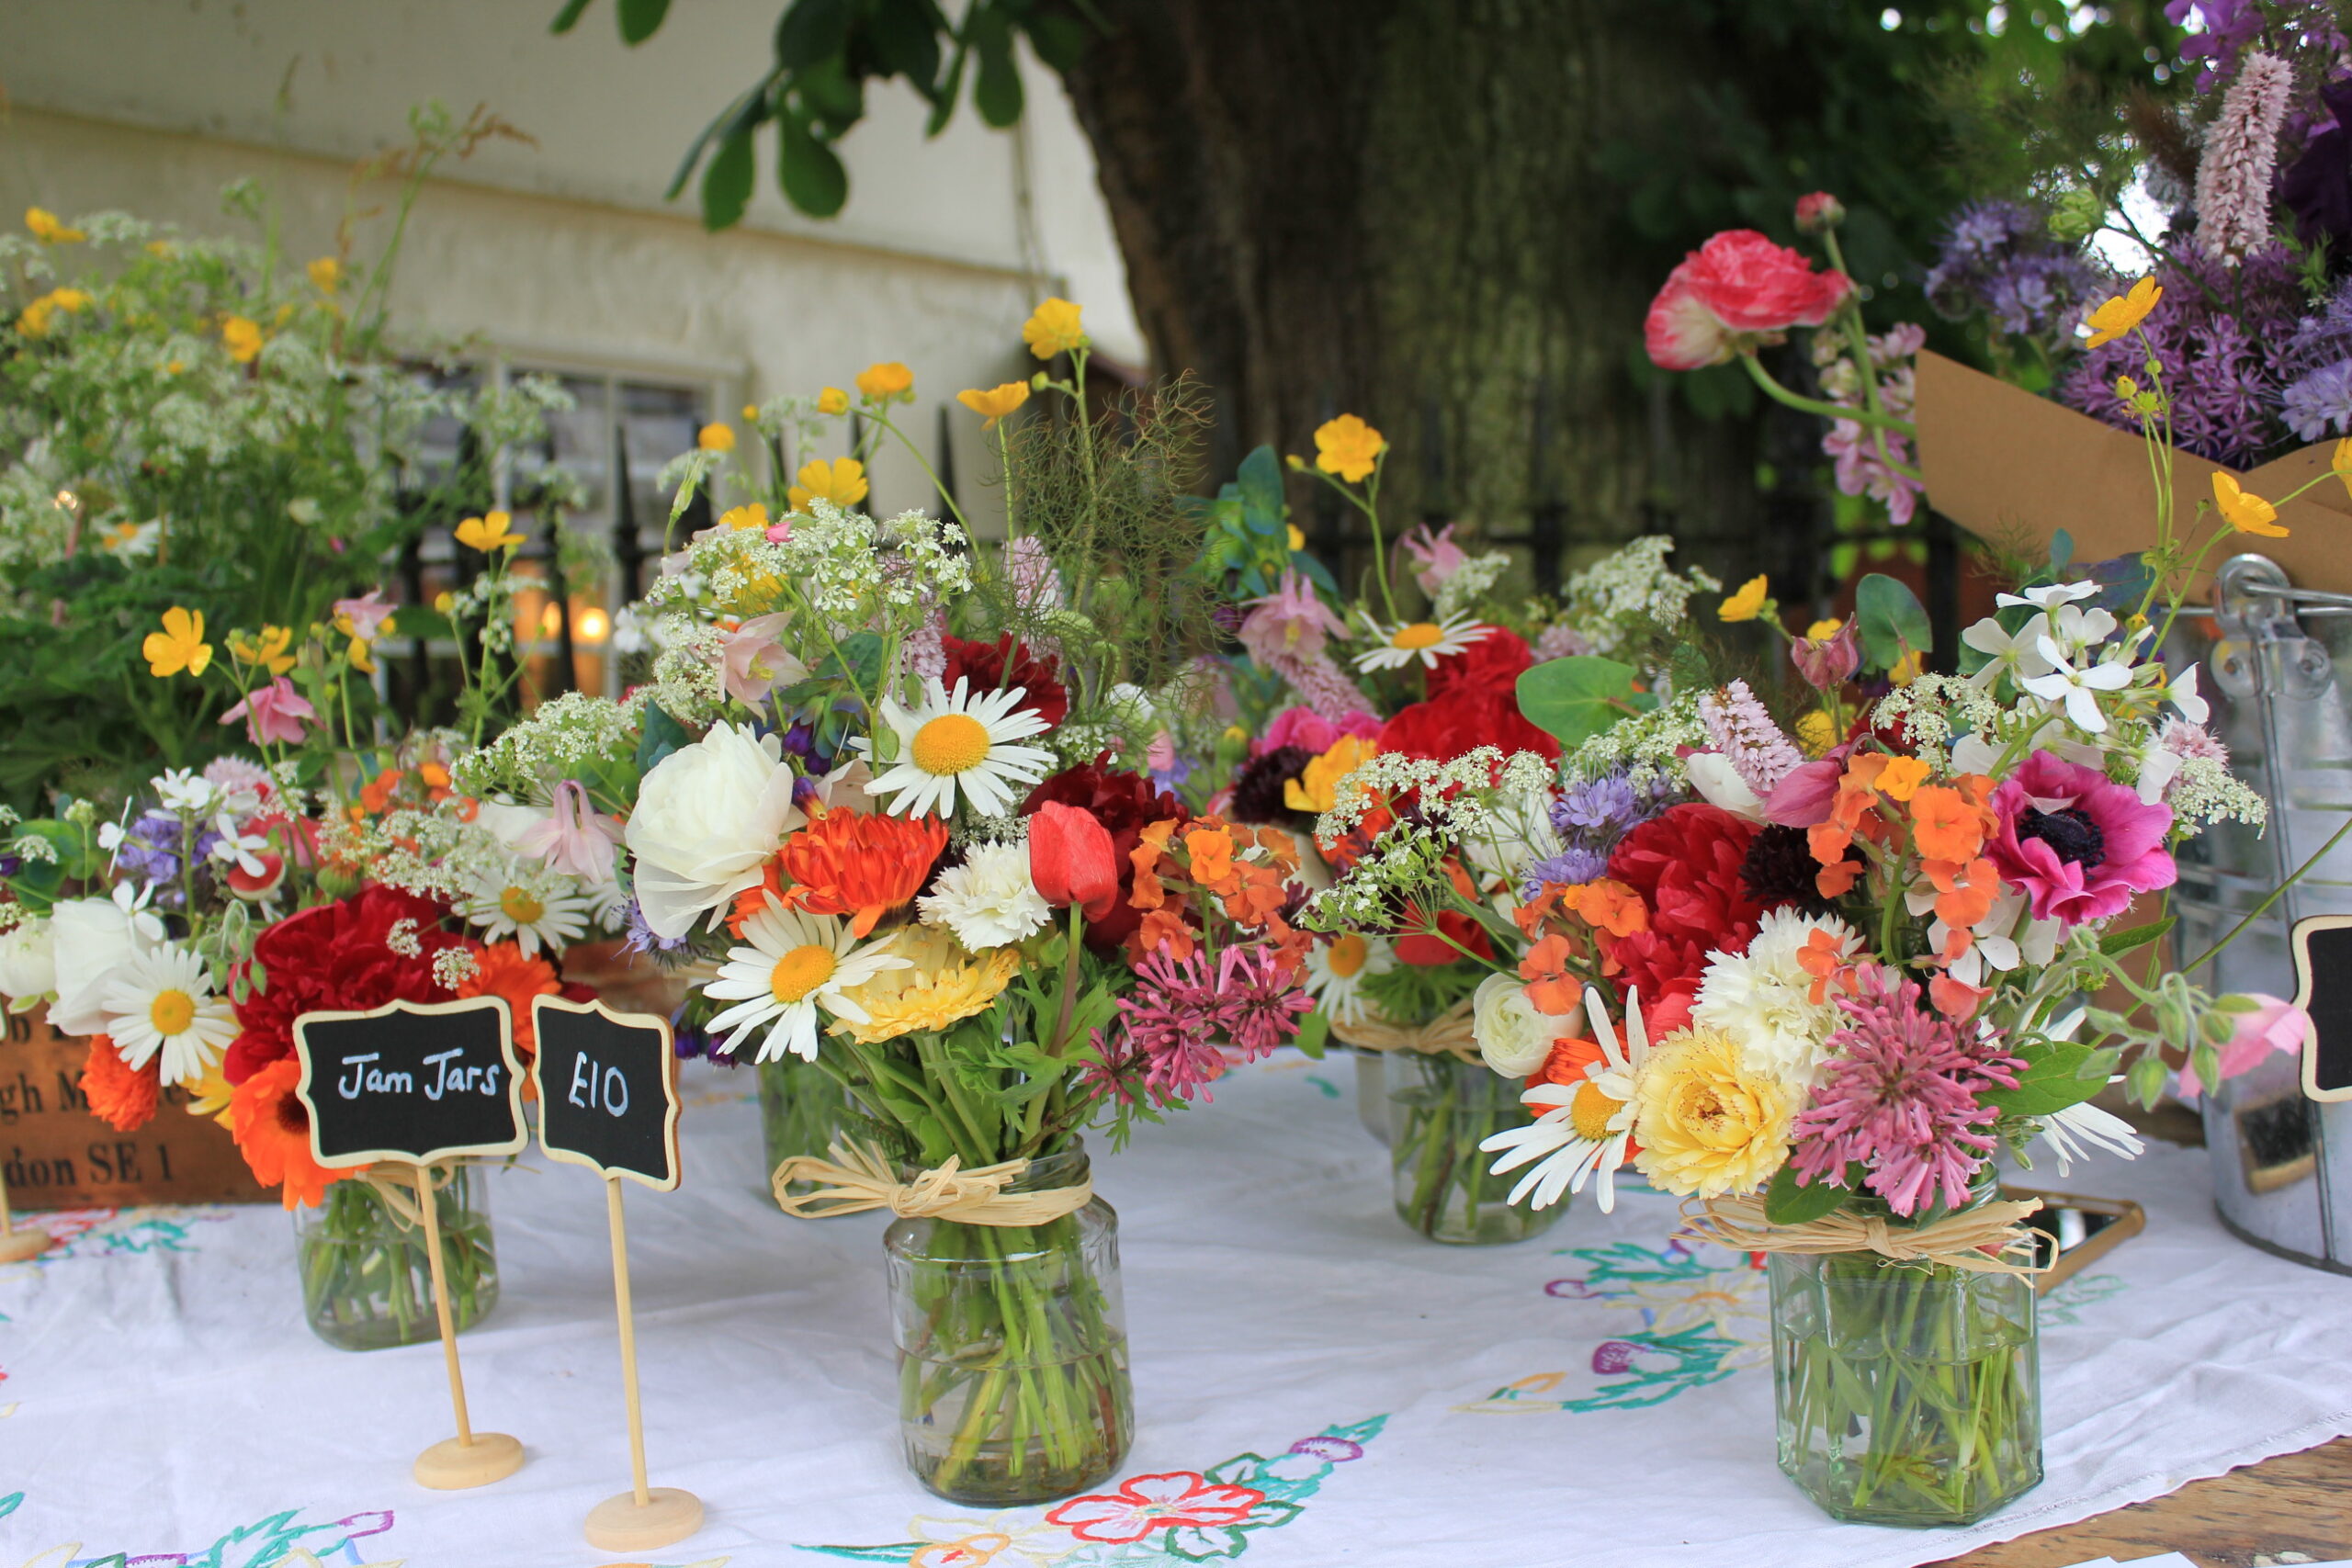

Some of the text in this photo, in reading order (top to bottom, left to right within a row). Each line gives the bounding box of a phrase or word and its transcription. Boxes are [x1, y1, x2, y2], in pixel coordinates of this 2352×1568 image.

[338, 1047, 501, 1101] Jam Jars
[569, 1051, 629, 1118] £10
[87, 1142, 142, 1185] SE
